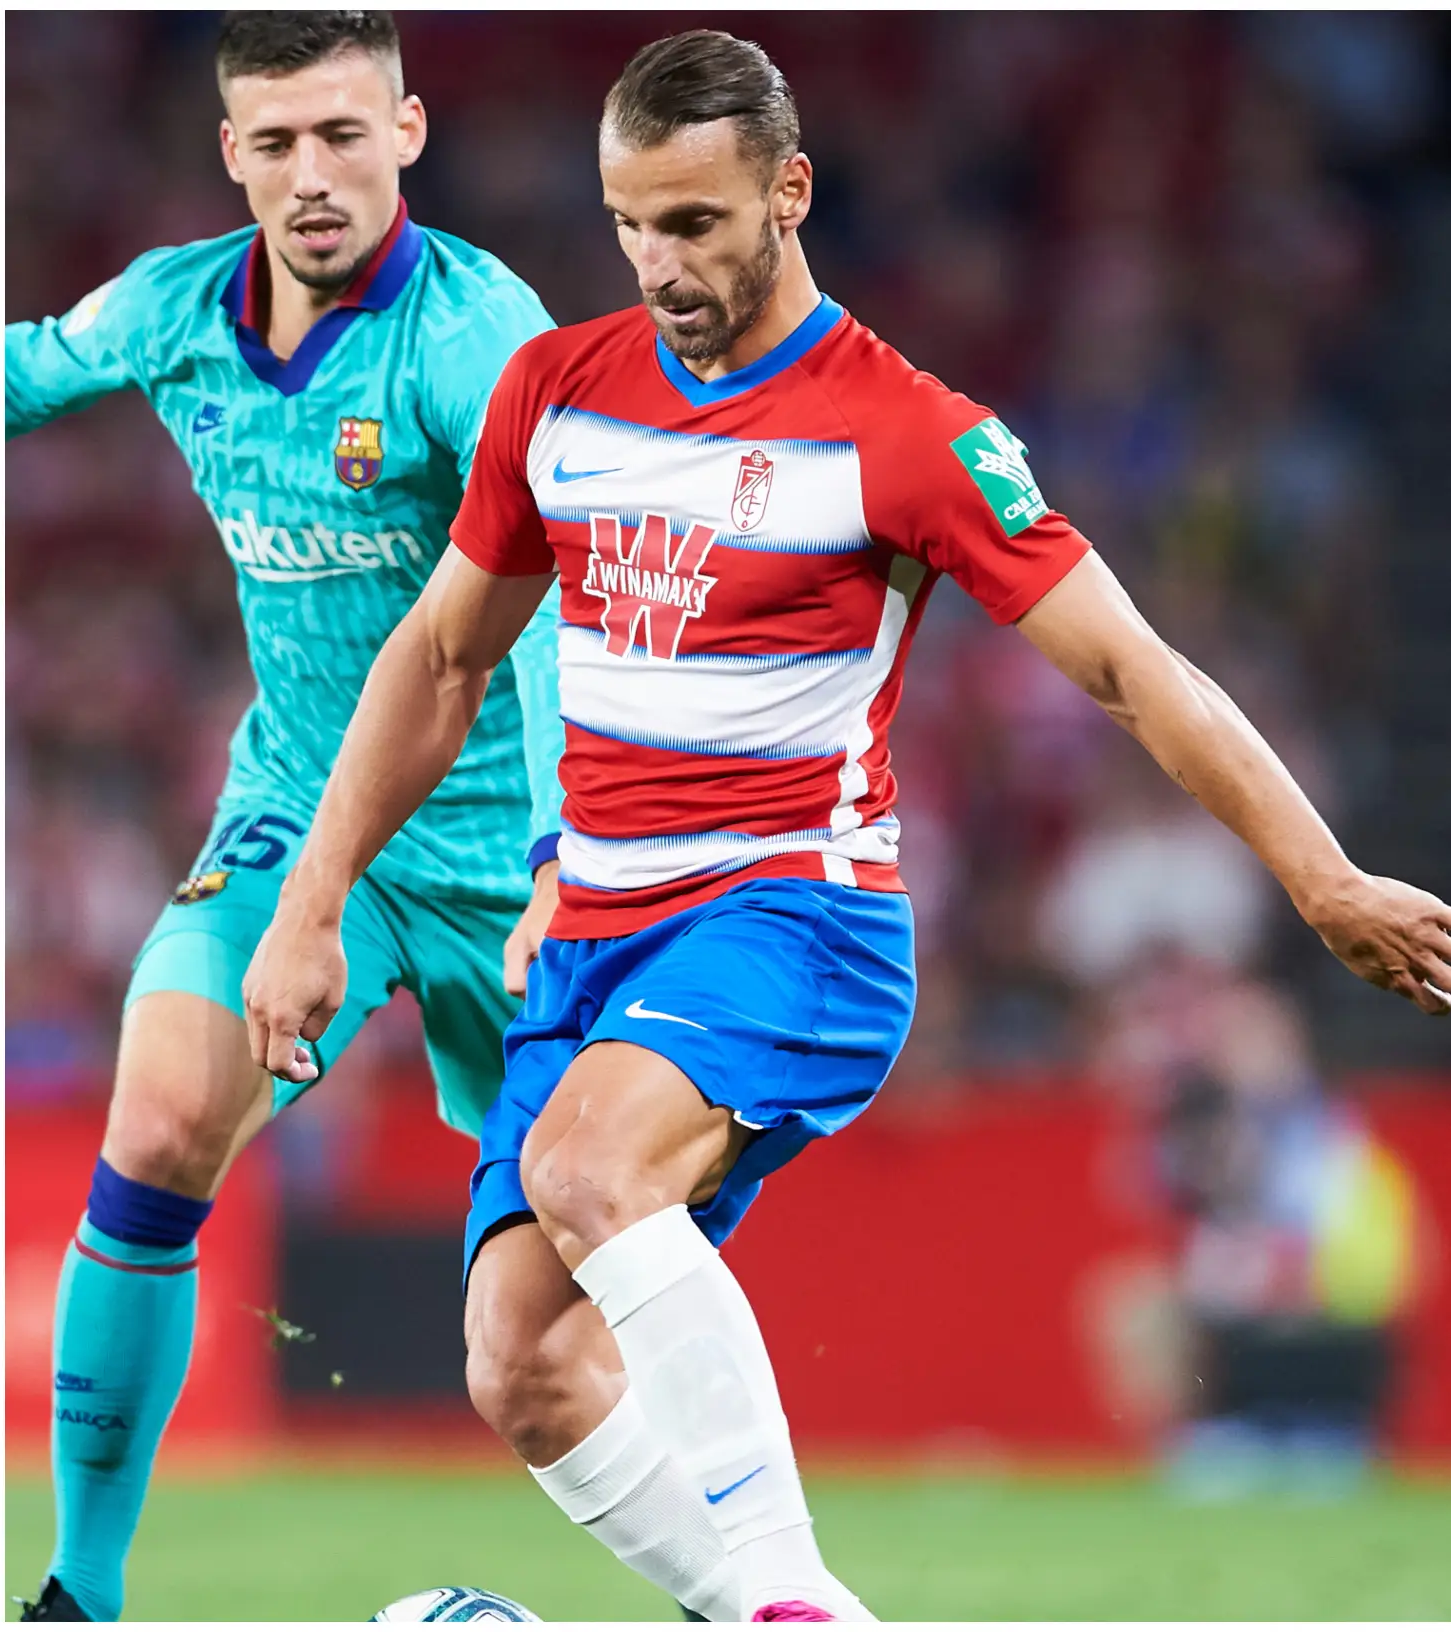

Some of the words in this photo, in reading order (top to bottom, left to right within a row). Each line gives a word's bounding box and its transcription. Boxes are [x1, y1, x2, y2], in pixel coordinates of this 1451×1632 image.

[221, 509, 423, 569] akuten
[599, 561, 696, 609] WINAMAX
[56, 1408, 128, 1432] ARÇA
